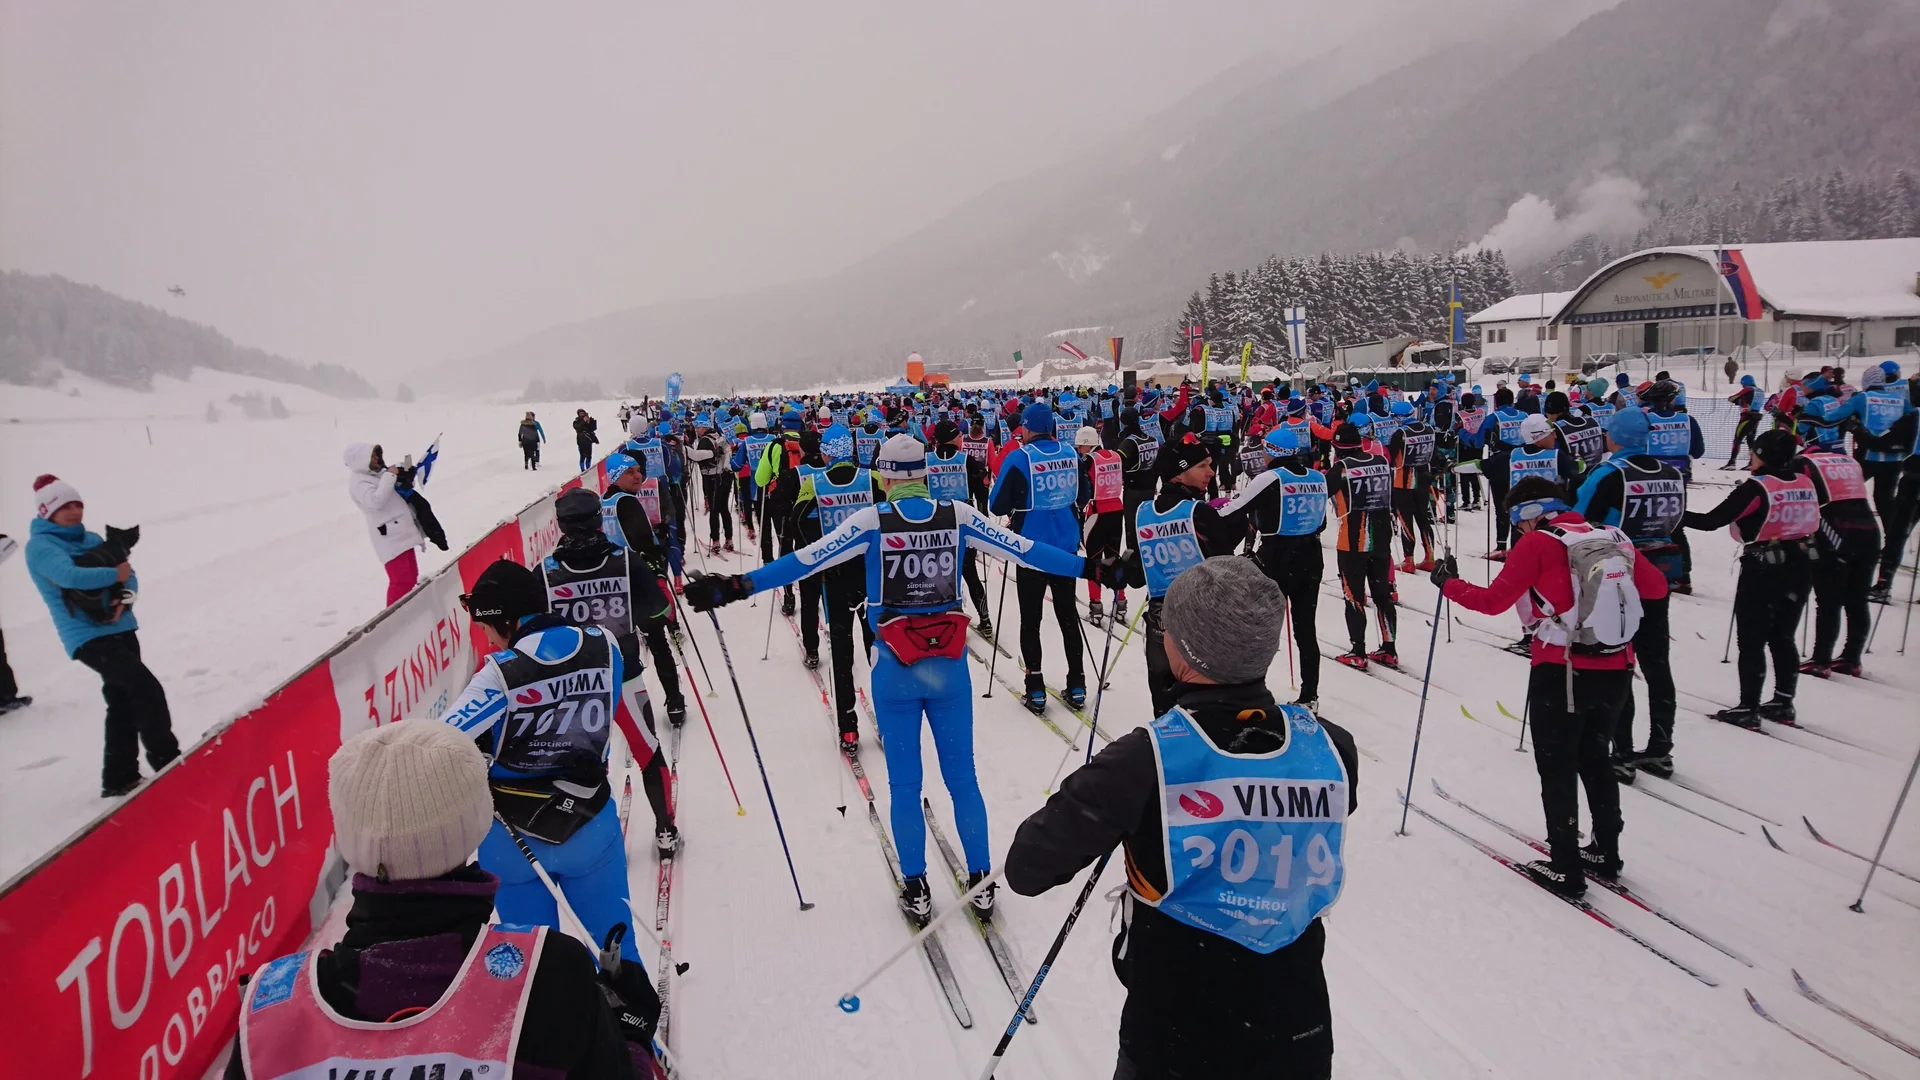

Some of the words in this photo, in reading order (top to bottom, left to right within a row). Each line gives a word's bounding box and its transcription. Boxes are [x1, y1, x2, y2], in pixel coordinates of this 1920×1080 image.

[1613, 292, 1670, 305] AERONAUTICA
[1674, 287, 1717, 300] MILITARE
[1059, 430, 1077, 439] 305
[1502, 429, 1521, 440] 301
[1579, 428, 1600, 438] VISMA
[1663, 422, 1687, 430] VISMA
[1651, 431, 1688, 446] 3036
[940, 465, 963, 473] VISMA
[1047, 459, 1074, 471] VISMA
[1363, 465, 1388, 475] VISMA
[1526, 460, 1552, 469] VISMA
[931, 474, 965, 489] 3061
[1035, 471, 1076, 492] 3060
[1298, 483, 1324, 493] VISMA
[1352, 475, 1389, 495] 7127
[1647, 481, 1679, 493] VISMA
[836, 492, 868, 505] VISMA
[1628, 496, 1681, 519] 7123
[971, 514, 1023, 551] TACKLA
[1155, 520, 1189, 537] VISMA
[811, 524, 862, 562] TACKLA
[908, 531, 953, 549] VISMA
[1140, 538, 1197, 568] 3099
[885, 551, 954, 579] 7069
[577, 579, 622, 596] VISMA
[554, 596, 626, 623] 7038
[364, 683, 381, 729] 3
[384, 607, 462, 723] ZINNEN
[547, 672, 606, 700] VISMA
[445, 688, 502, 728] CKLA
[511, 698, 606, 739] 7070
[1232, 784, 1331, 818] VISMA
[1182, 828, 1336, 890] 3019
[55, 750, 303, 1080] TOBLACH
